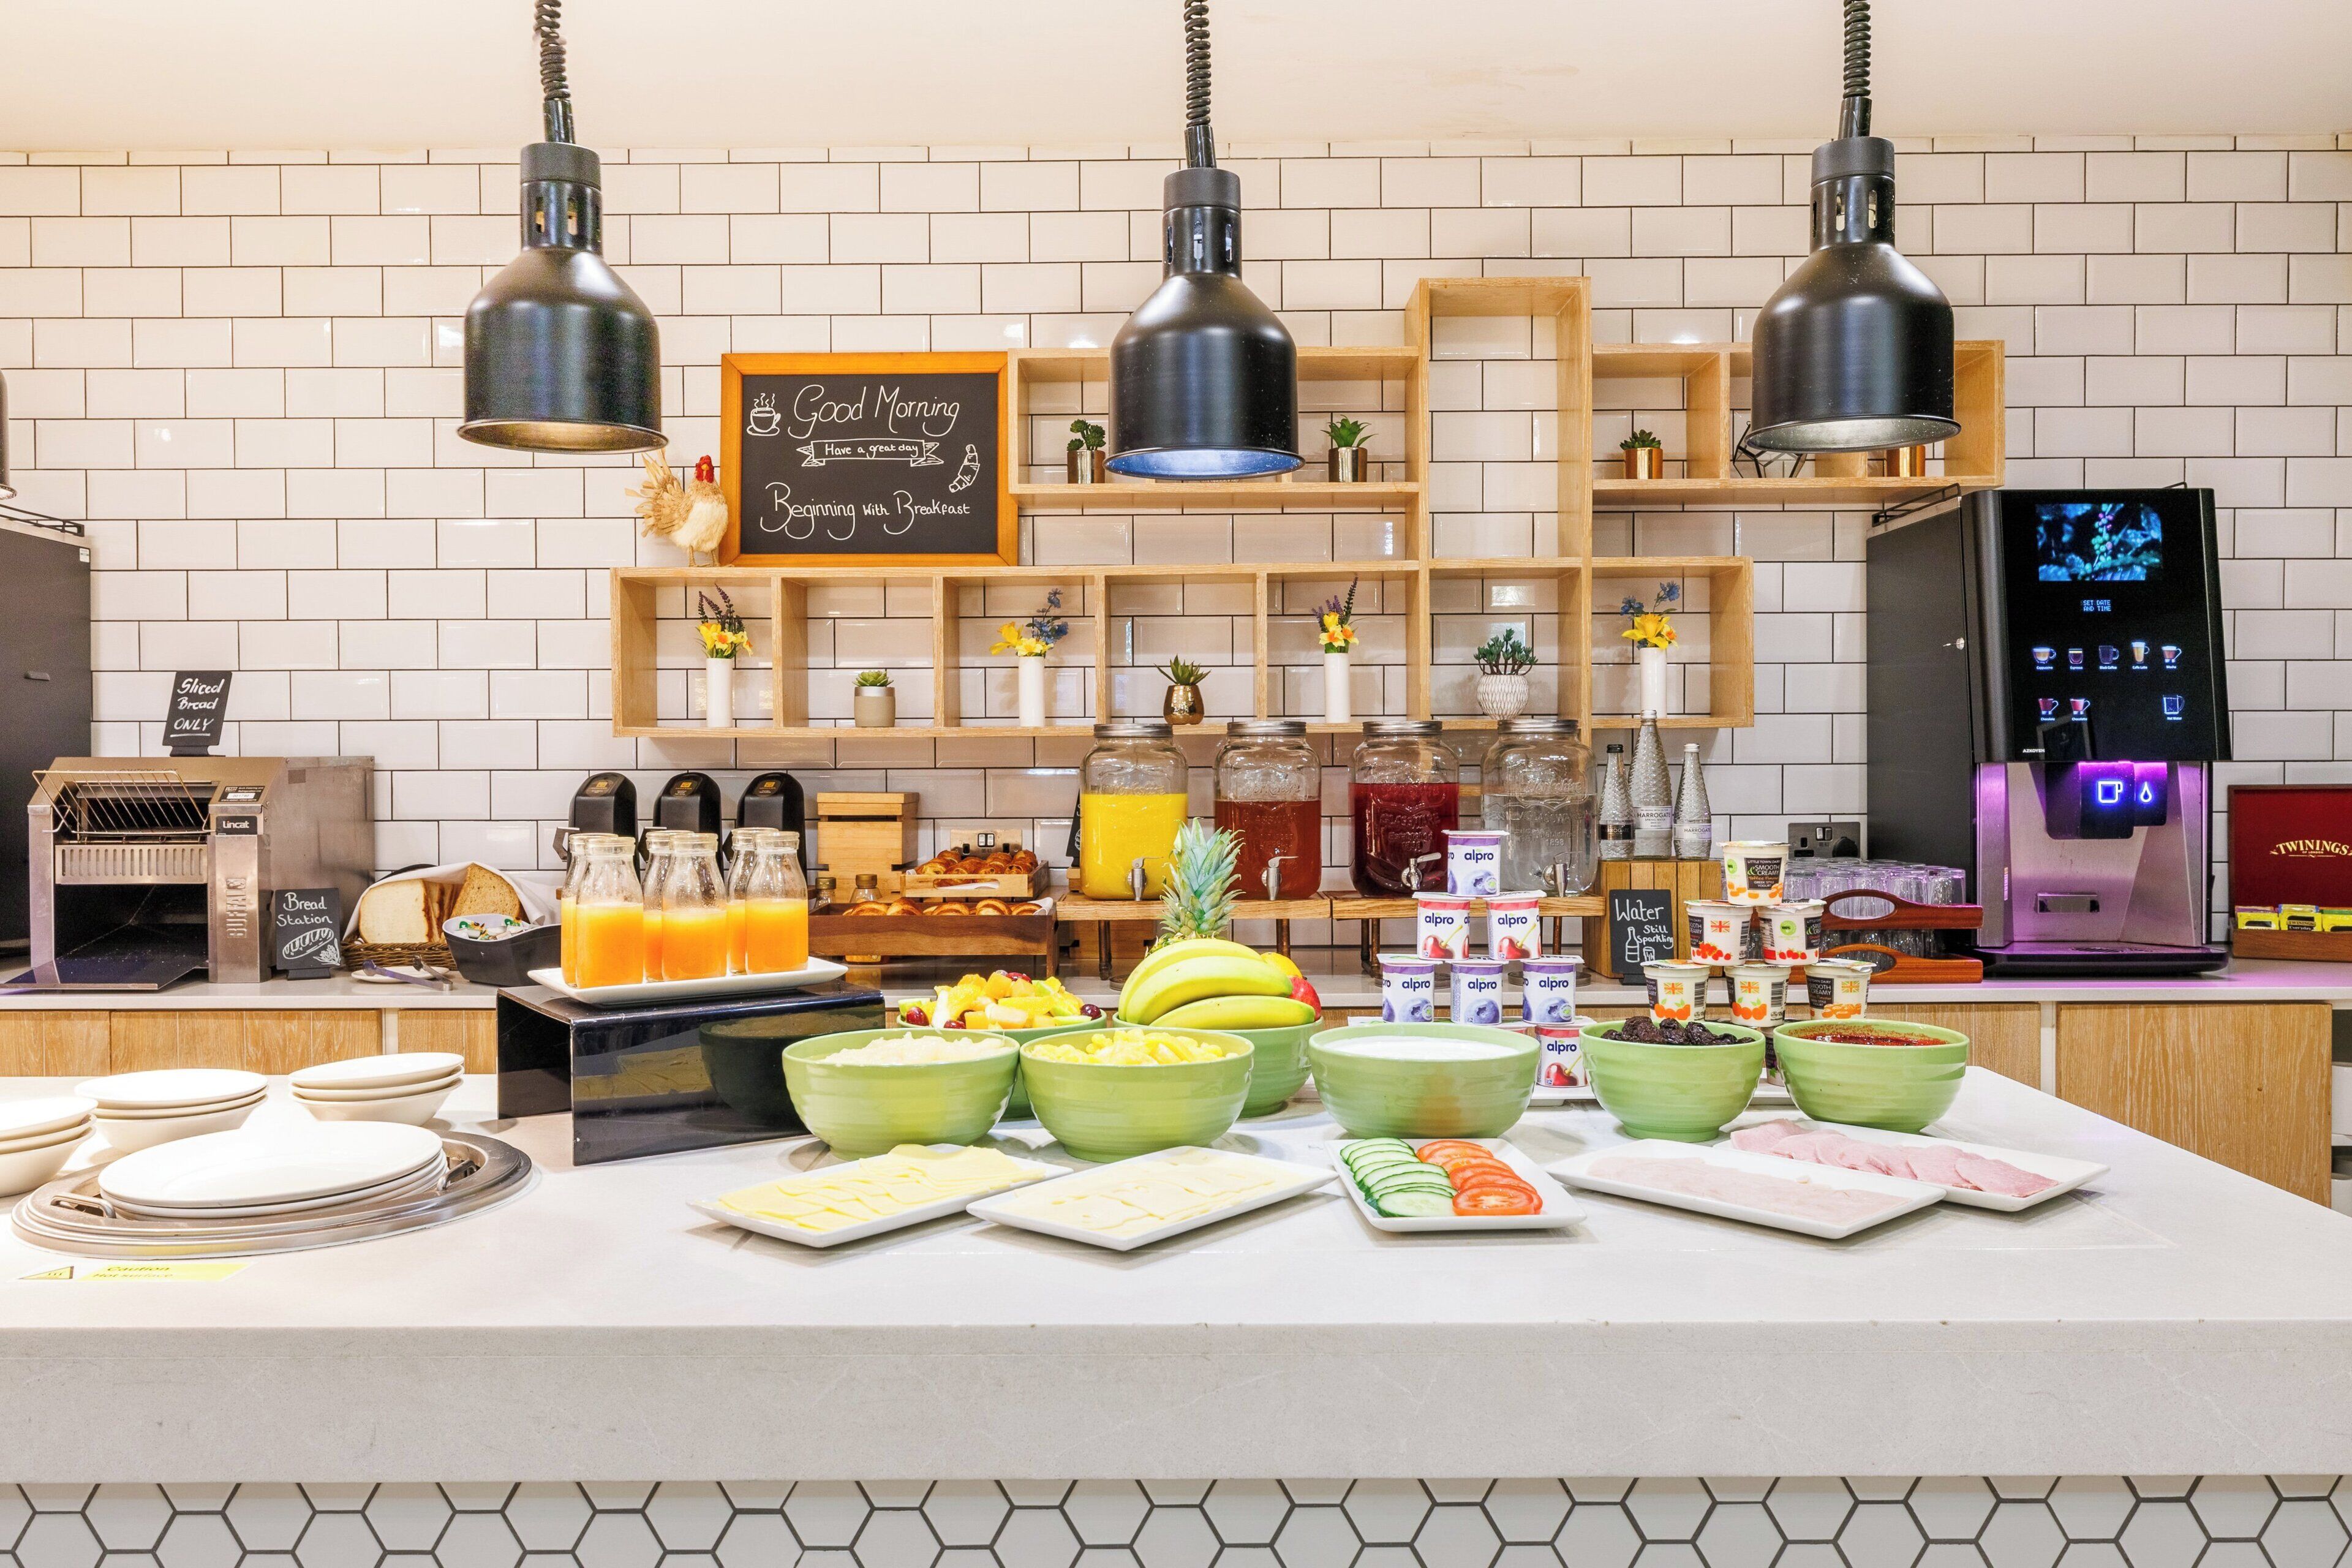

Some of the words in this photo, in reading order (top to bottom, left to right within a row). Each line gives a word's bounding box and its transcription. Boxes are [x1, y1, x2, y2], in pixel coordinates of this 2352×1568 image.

[788, 385, 866, 439] Good
[875, 385, 960, 437] Morning
[825, 444, 852, 455] Have
[867, 444, 897, 458] great
[898, 443, 918, 458] day
[760, 482, 856, 540] Beginning
[884, 491, 970, 535] Breakfast
[177, 678, 225, 696] Sliced
[177, 697, 219, 710] Bread
[174, 718, 214, 731] ONLY
[2276, 840, 2350, 855] TWININGS
[1464, 850, 1494, 864] alpro
[283, 892, 328, 911] Bread
[1615, 899, 1664, 921] Water
[276, 913, 333, 927] Station
[1425, 912, 1454, 927] alpro
[1498, 914, 1528, 928] alpro
[1643, 925, 1668, 933] Still
[1402, 976, 1431, 991] alpro
[1468, 978, 1497, 992] alpro
[1539, 976, 1569, 991] alpro
[1547, 1040, 1577, 1054] alpro
